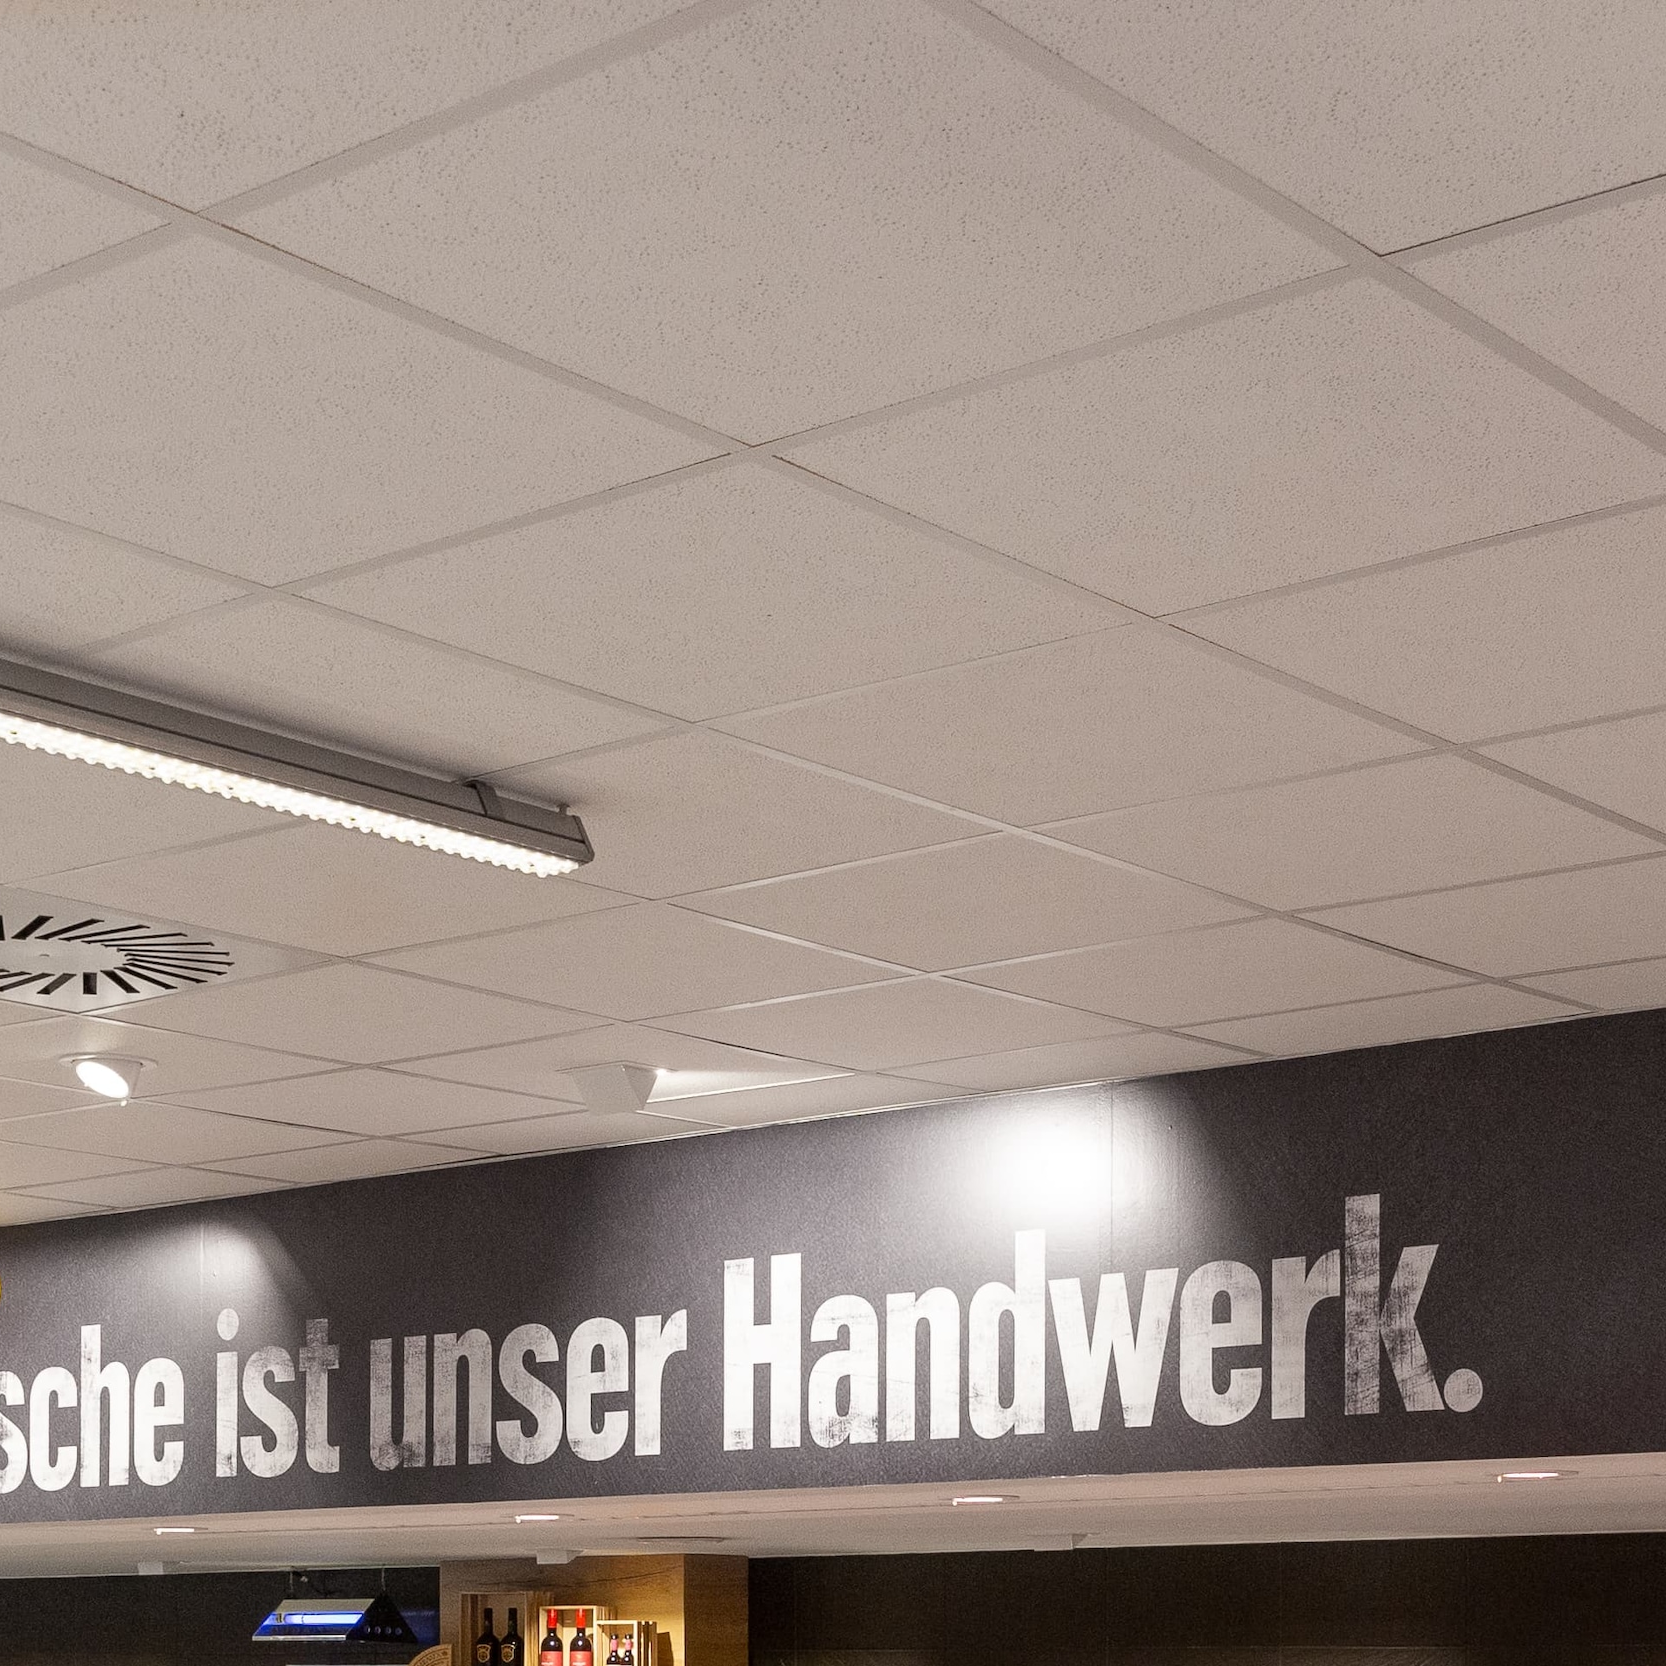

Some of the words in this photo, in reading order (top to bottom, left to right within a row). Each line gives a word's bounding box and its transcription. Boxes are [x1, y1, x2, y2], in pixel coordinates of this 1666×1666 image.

[216, 1308, 340, 1479] ist
[369, 1309, 688, 1471] unser
[723, 1193, 1484, 1452] Handwerk.
